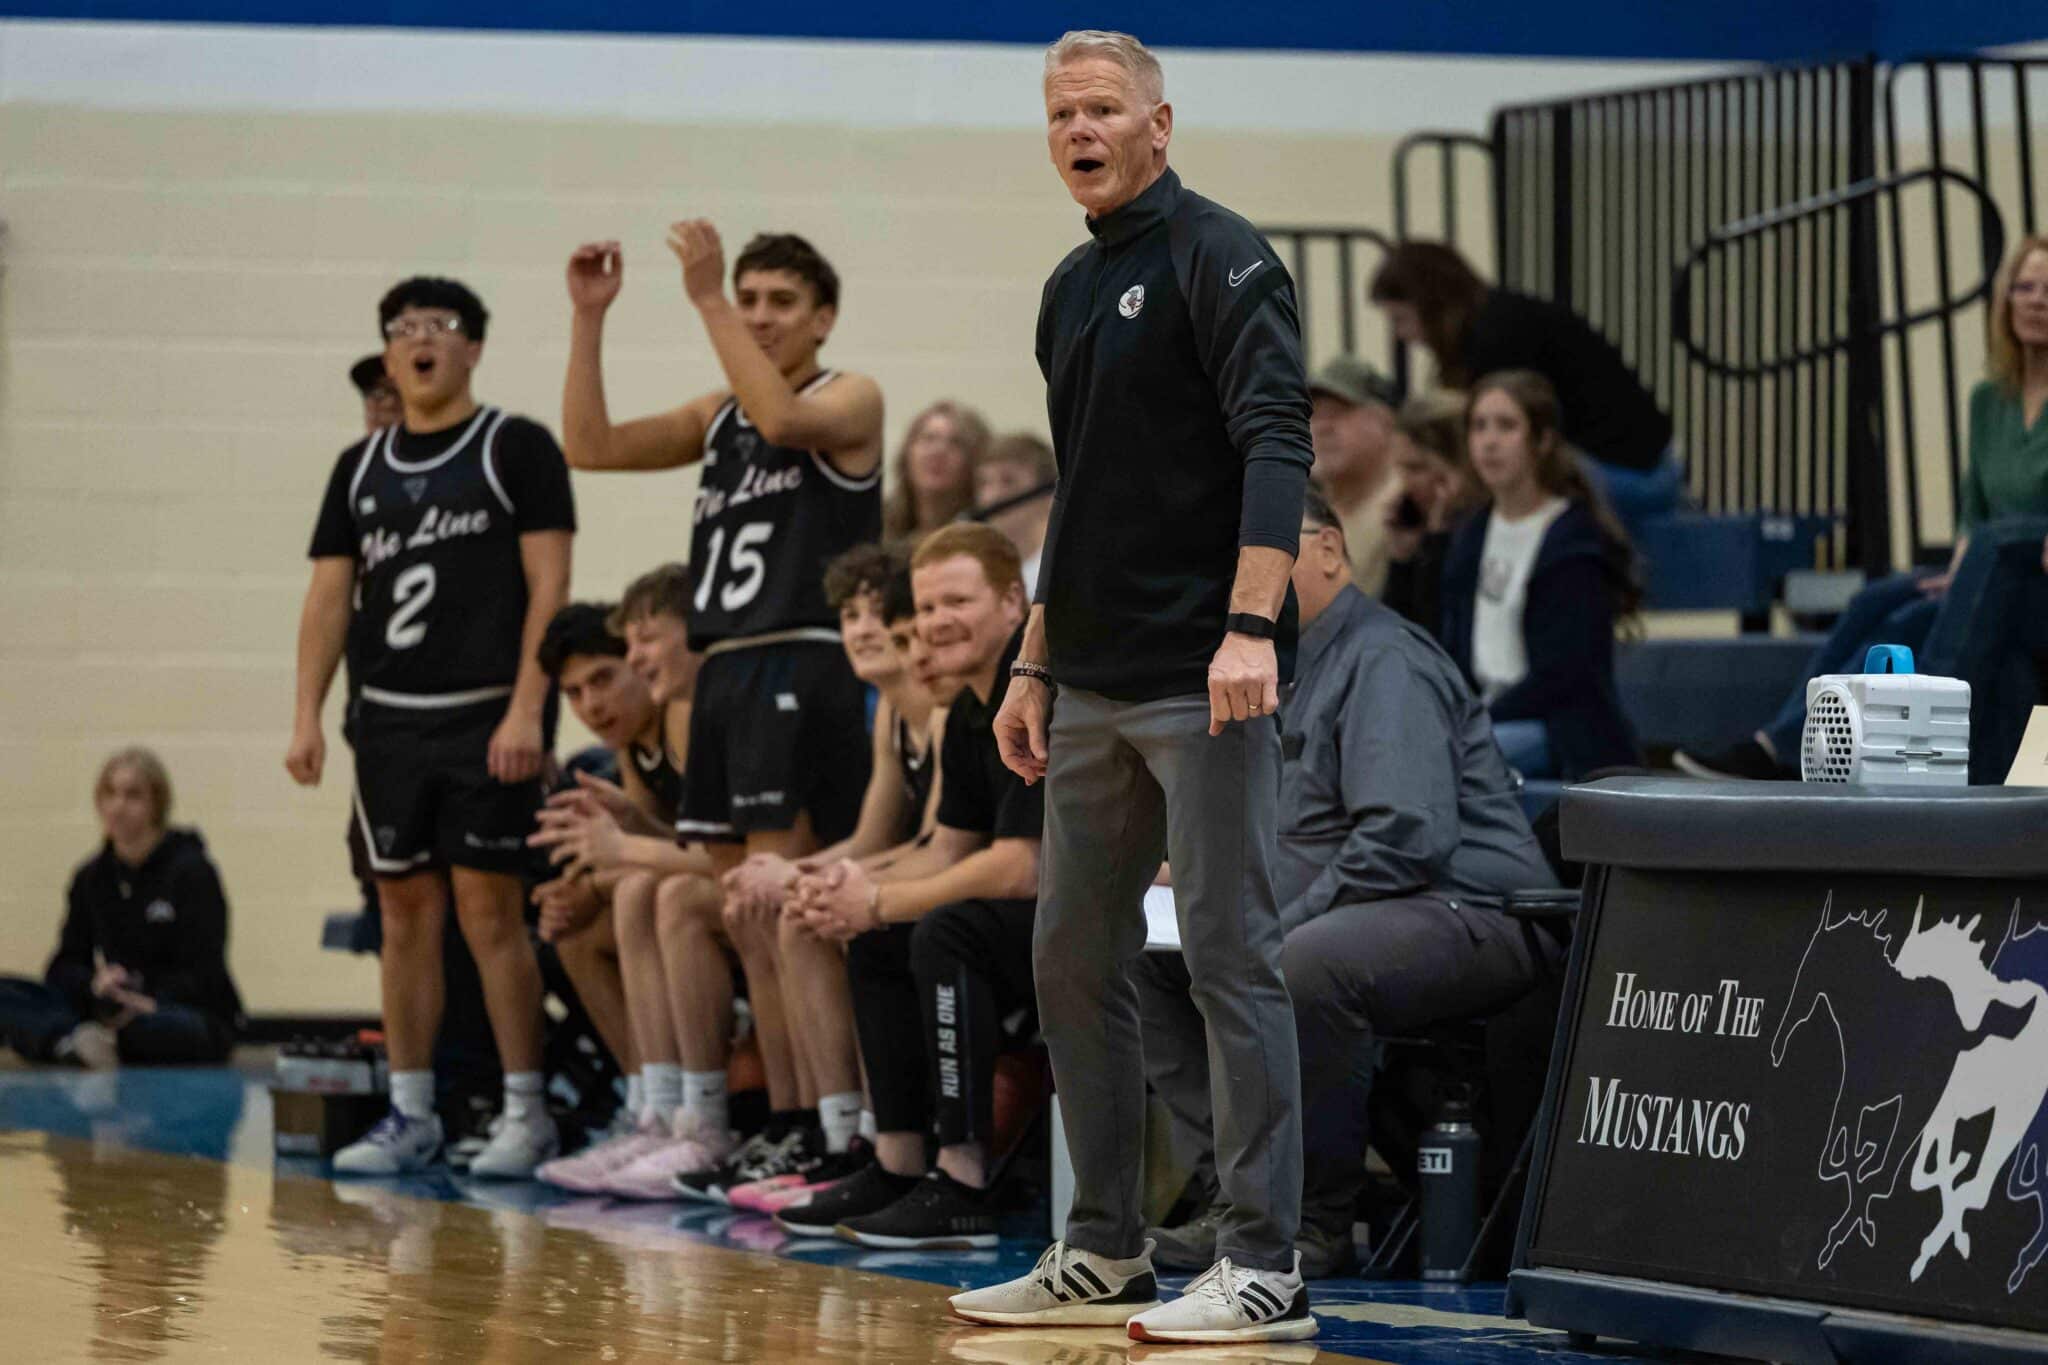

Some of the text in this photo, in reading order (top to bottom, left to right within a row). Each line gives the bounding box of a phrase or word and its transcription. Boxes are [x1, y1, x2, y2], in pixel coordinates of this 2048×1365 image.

[729, 464, 802, 507] Line
[406, 505, 490, 549] Line
[694, 522, 775, 611] 15
[386, 562, 436, 649] 2
[937, 984, 960, 1098] RUN AS ONE
[1419, 1153, 1448, 1169] ETI
